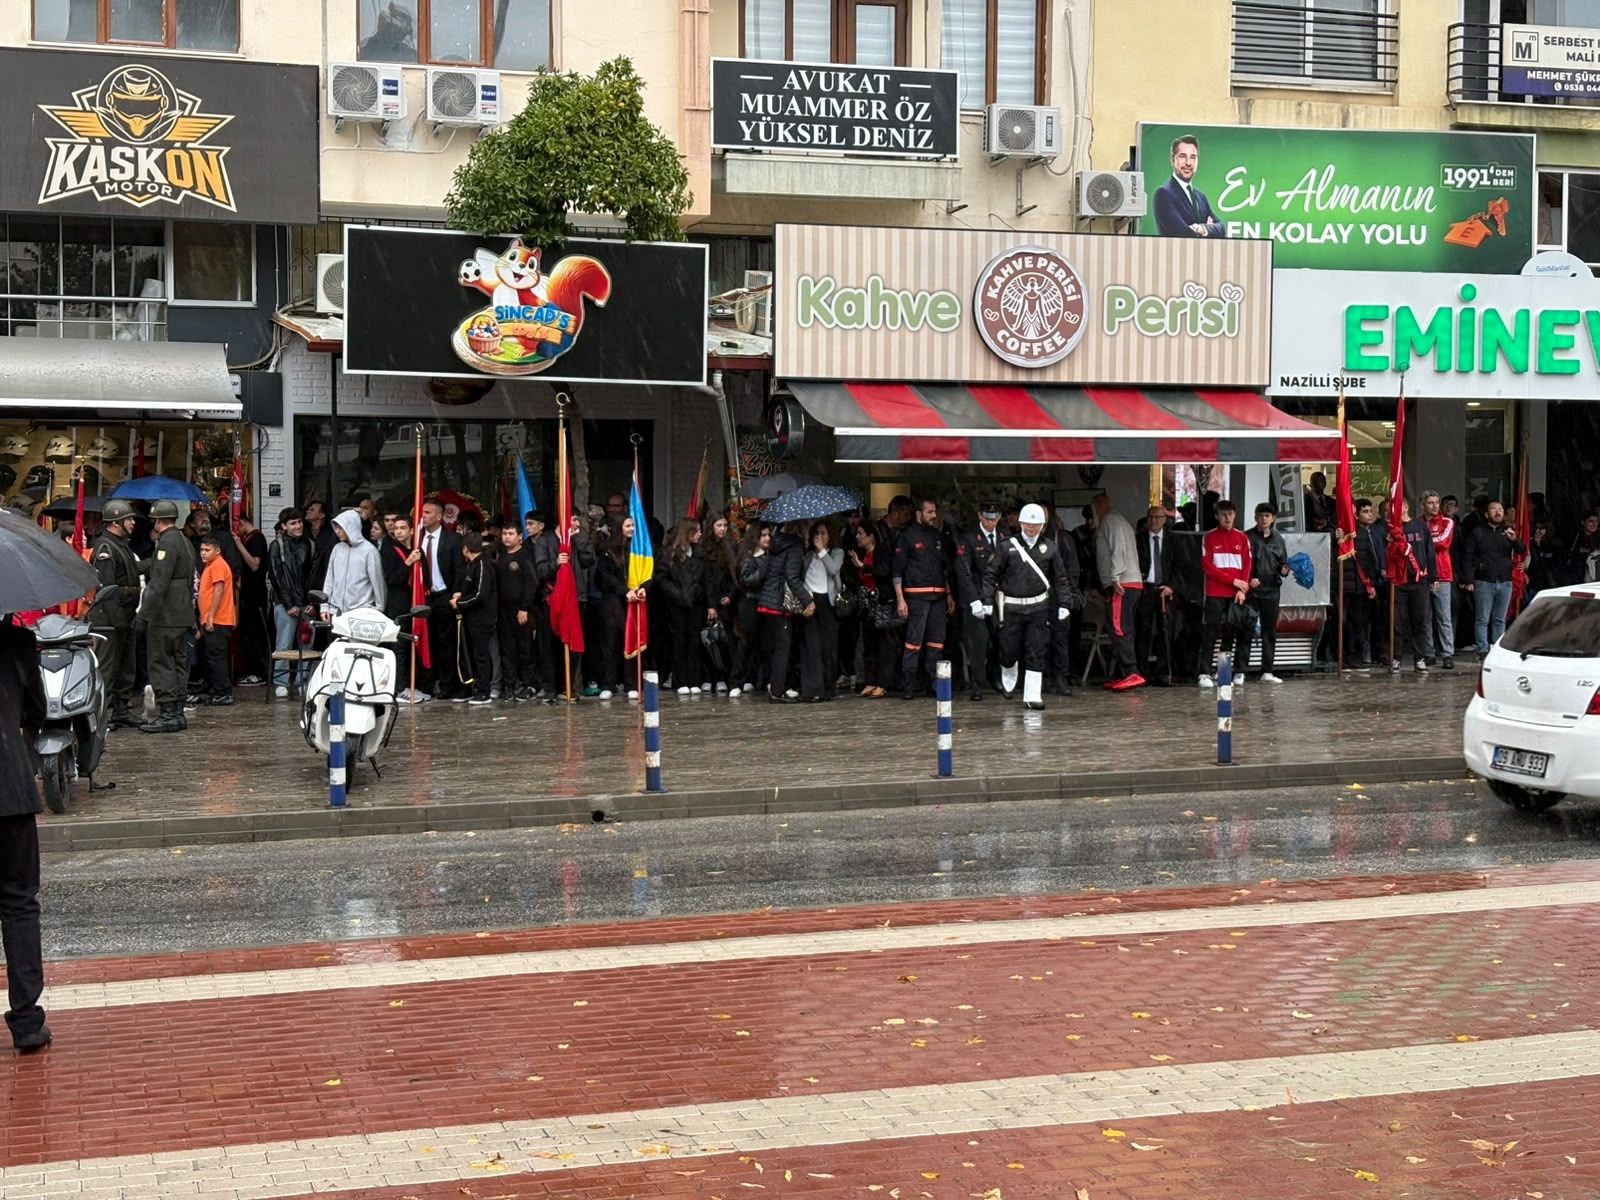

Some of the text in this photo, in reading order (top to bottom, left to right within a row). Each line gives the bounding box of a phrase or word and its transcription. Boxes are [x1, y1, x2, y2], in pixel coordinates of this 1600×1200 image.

[1544, 36, 1594, 48] SERBEST
[1566, 50, 1594, 62] MALİ
[783, 69, 891, 94] AVUKAT
[1527, 70, 1573, 81] MEHMET
[740, 93, 932, 122] MUAMMER ÖZ
[738, 116, 934, 149] YÜKSEL DENİZ
[105, 182, 173, 196] MOTOR
[1217, 164, 1437, 213] Ev Almanın
[1269, 222, 1354, 243] KOLAY
[1360, 224, 1427, 245] YOLU
[987, 256, 1034, 299] KAHVE
[798, 276, 1243, 337] Kahve Perisi
[1344, 283, 1600, 375] EMİNE
[996, 329, 1067, 356] COFFEE
[1280, 373, 1366, 391] NAZİLLİ ŞUBE
